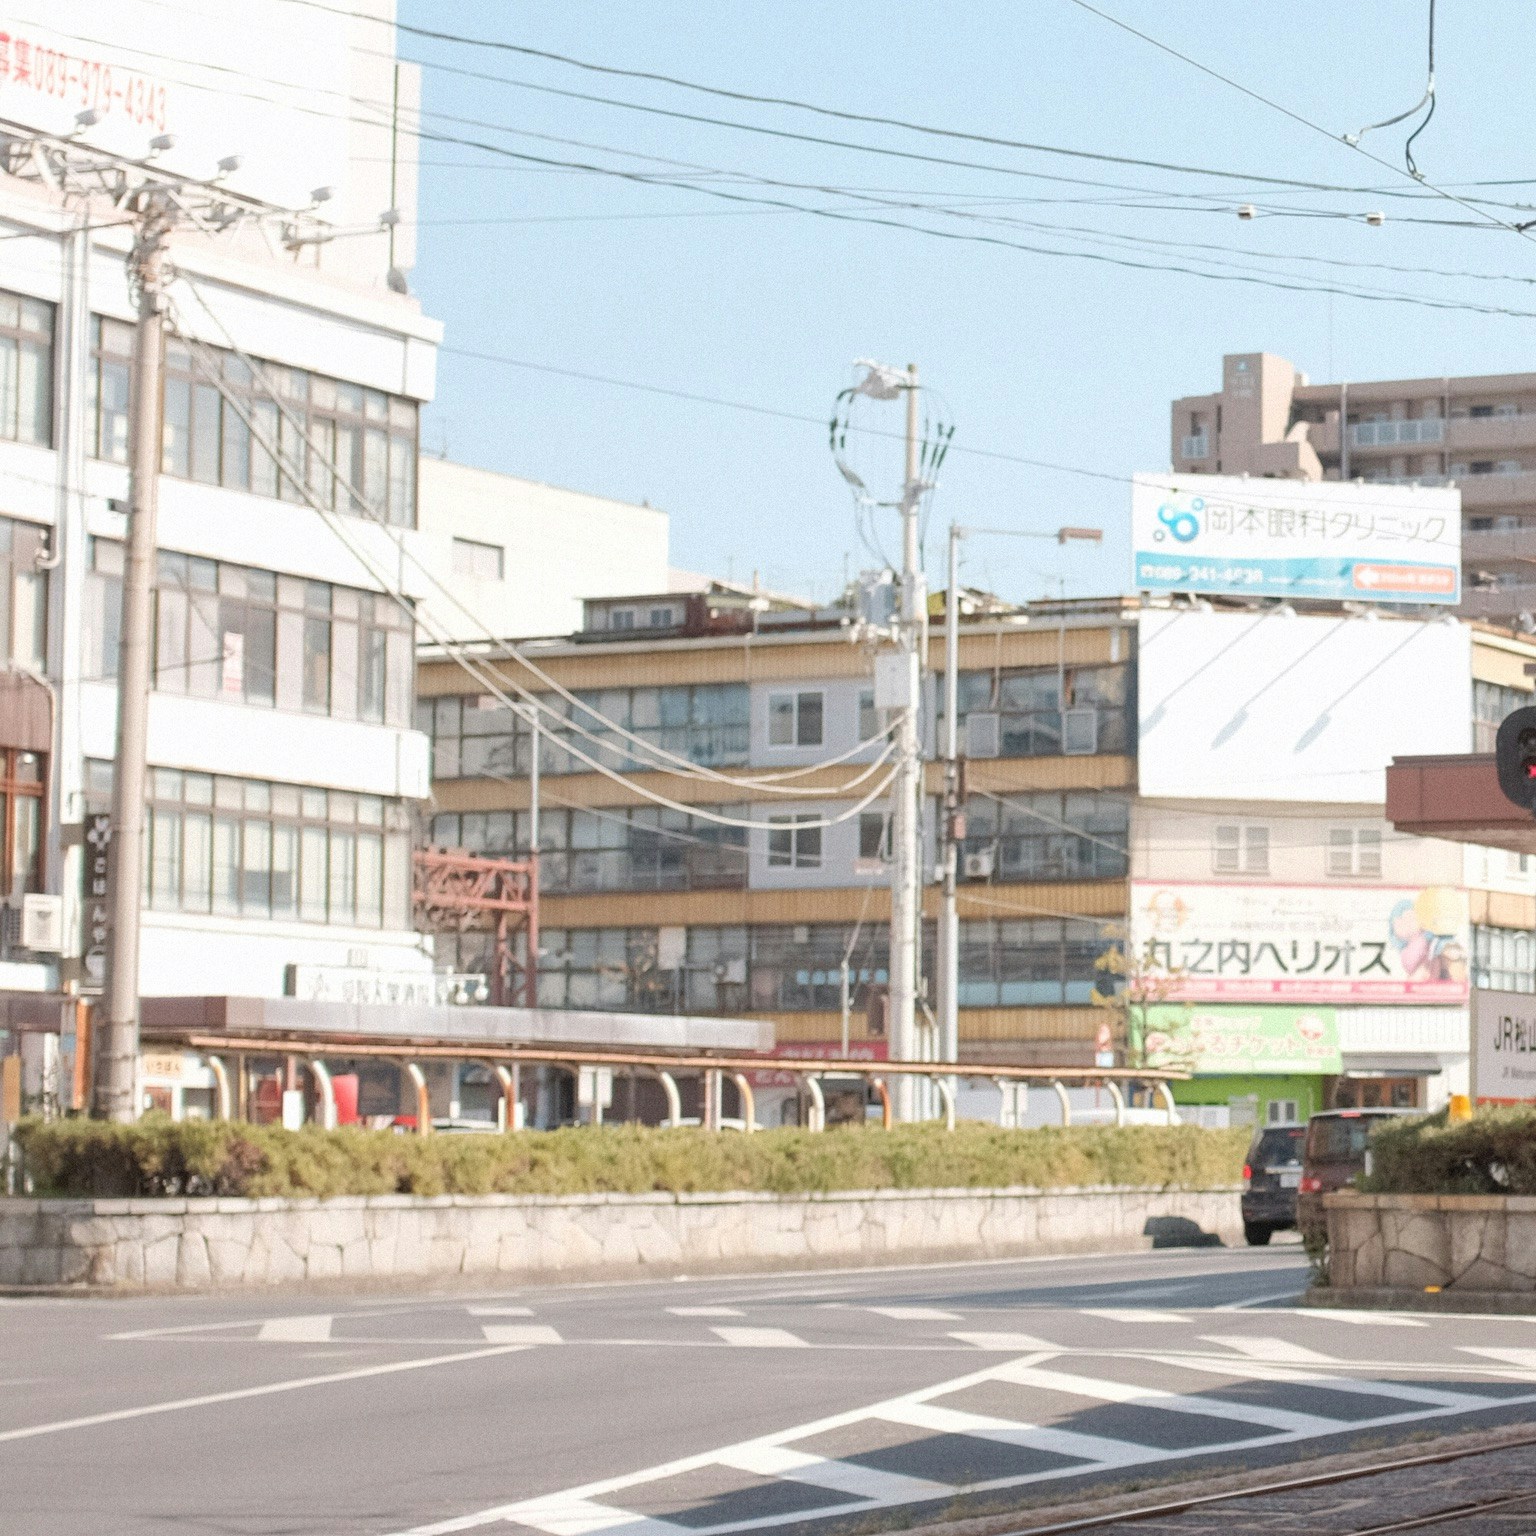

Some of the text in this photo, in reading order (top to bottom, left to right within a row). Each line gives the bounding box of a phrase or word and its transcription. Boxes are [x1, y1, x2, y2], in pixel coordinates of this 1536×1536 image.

[1204, 503, 1446, 543] 岡本眼科クリニック
[1142, 938, 1391, 975] 丸之内ヘリオス
